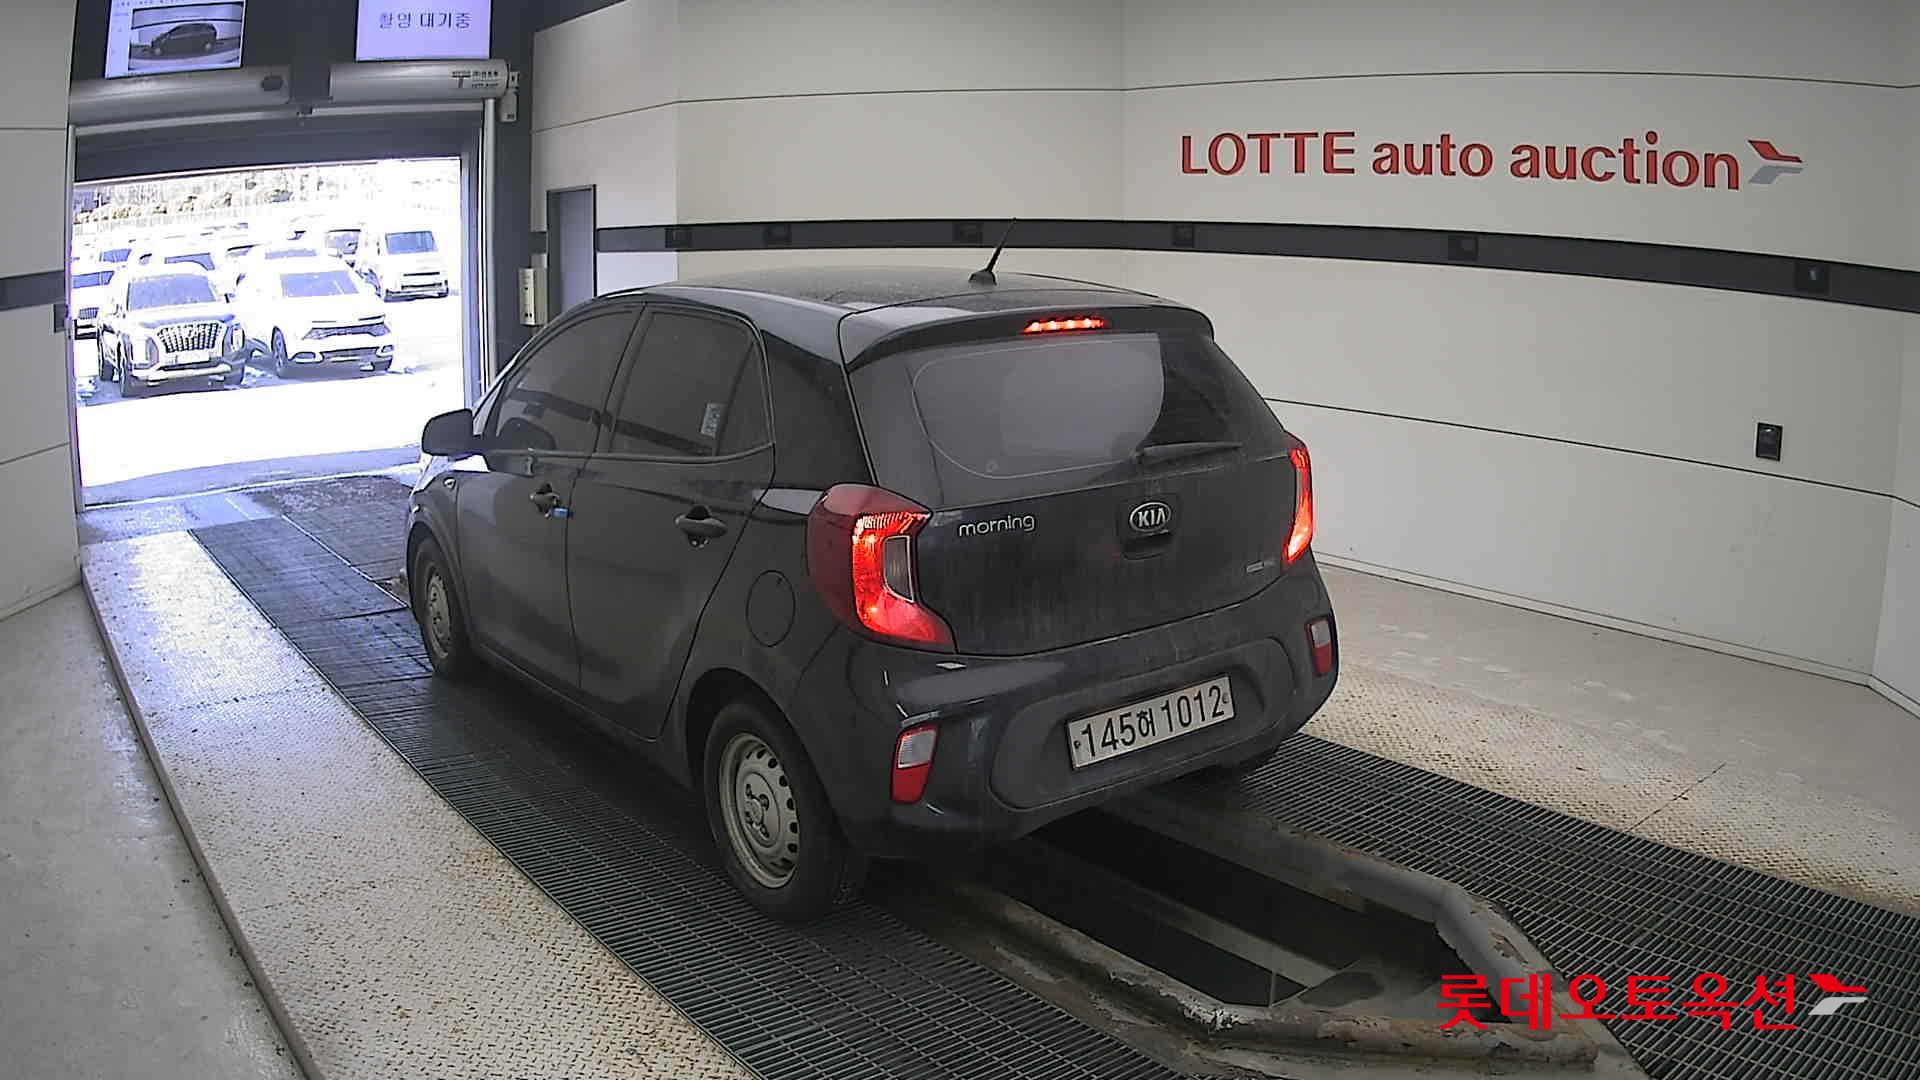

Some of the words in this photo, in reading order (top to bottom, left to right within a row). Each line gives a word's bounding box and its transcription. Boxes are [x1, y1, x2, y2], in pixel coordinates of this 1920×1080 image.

[420, 12, 472, 29] 대기중
[1182, 132, 1354, 175] LOTTE
[1372, 134, 1493, 177] auto
[1510, 132, 1740, 190] auction
[958, 514, 1036, 537] morning
[1137, 507, 1166, 528] KIA
[1081, 707, 1156, 757] 145허
[1161, 685, 1225, 733] 1012
